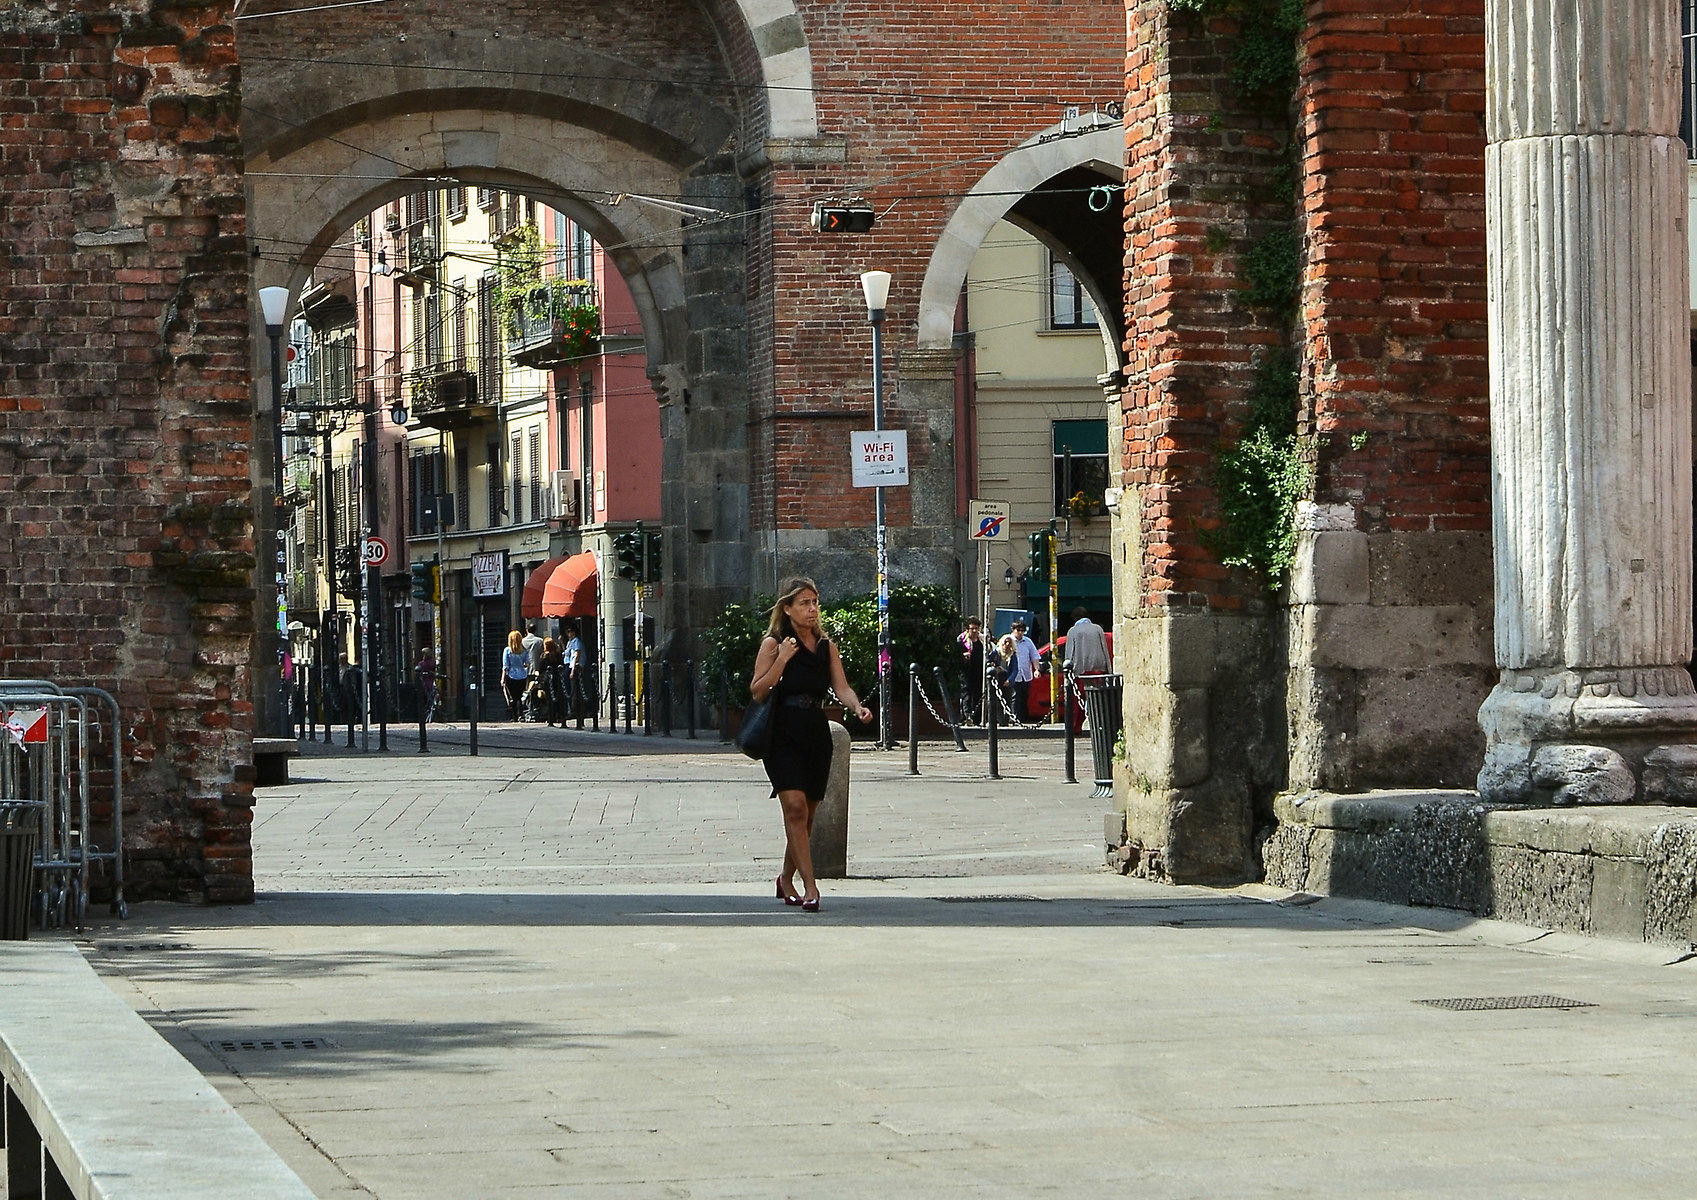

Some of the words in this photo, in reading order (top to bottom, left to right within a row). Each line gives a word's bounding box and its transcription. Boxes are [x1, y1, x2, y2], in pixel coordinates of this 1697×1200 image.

[863, 442, 894, 453] Wi-Fi
[864, 453, 894, 462] area
[366, 544, 383, 559] 30
[473, 553, 501, 574] PIZZERIA
